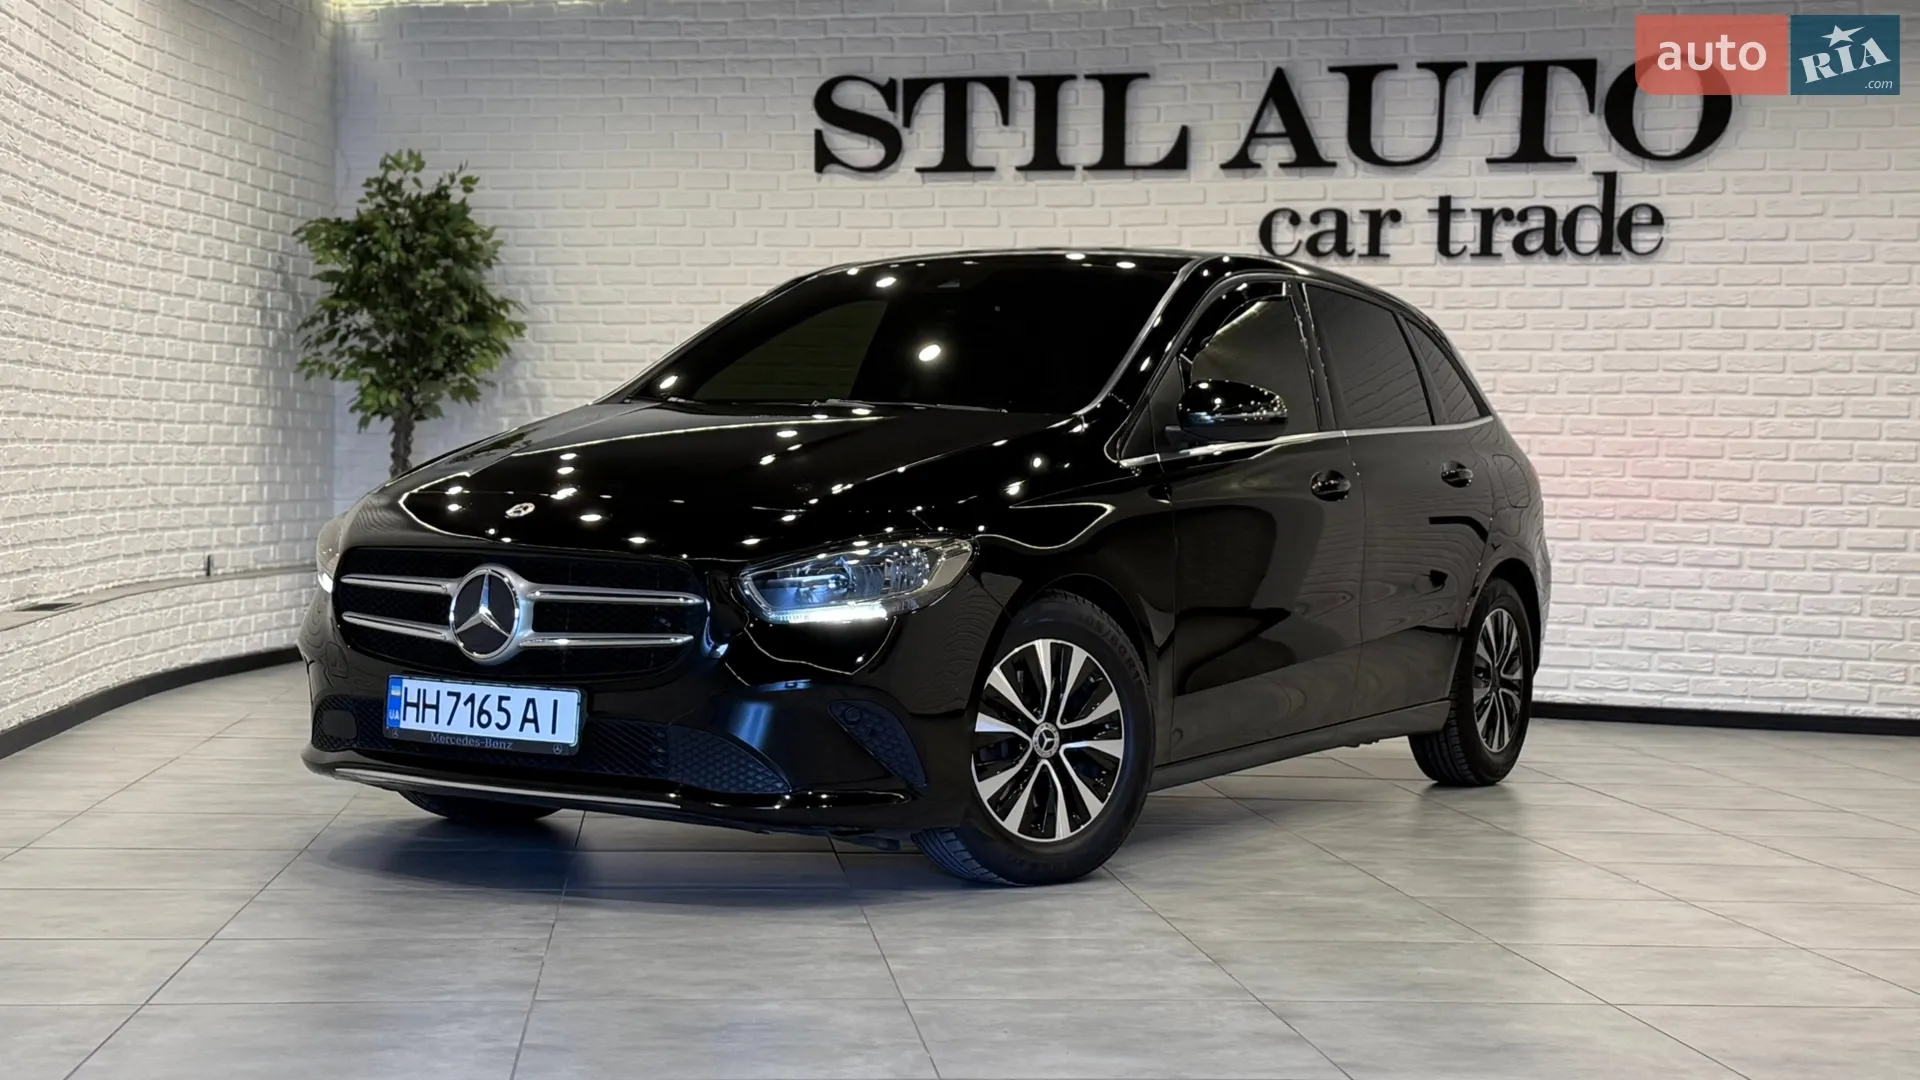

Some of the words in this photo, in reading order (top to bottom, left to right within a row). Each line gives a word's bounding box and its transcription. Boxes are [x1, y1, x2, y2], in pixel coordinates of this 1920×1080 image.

[813, 74, 1189, 174] STIL
[1219, 52, 1733, 170] AUTO
[1258, 206, 1402, 258] car
[1427, 171, 1666, 258] trade
[388, 710, 400, 721] UA
[430, 732, 514, 750] Mercedes-Benz
